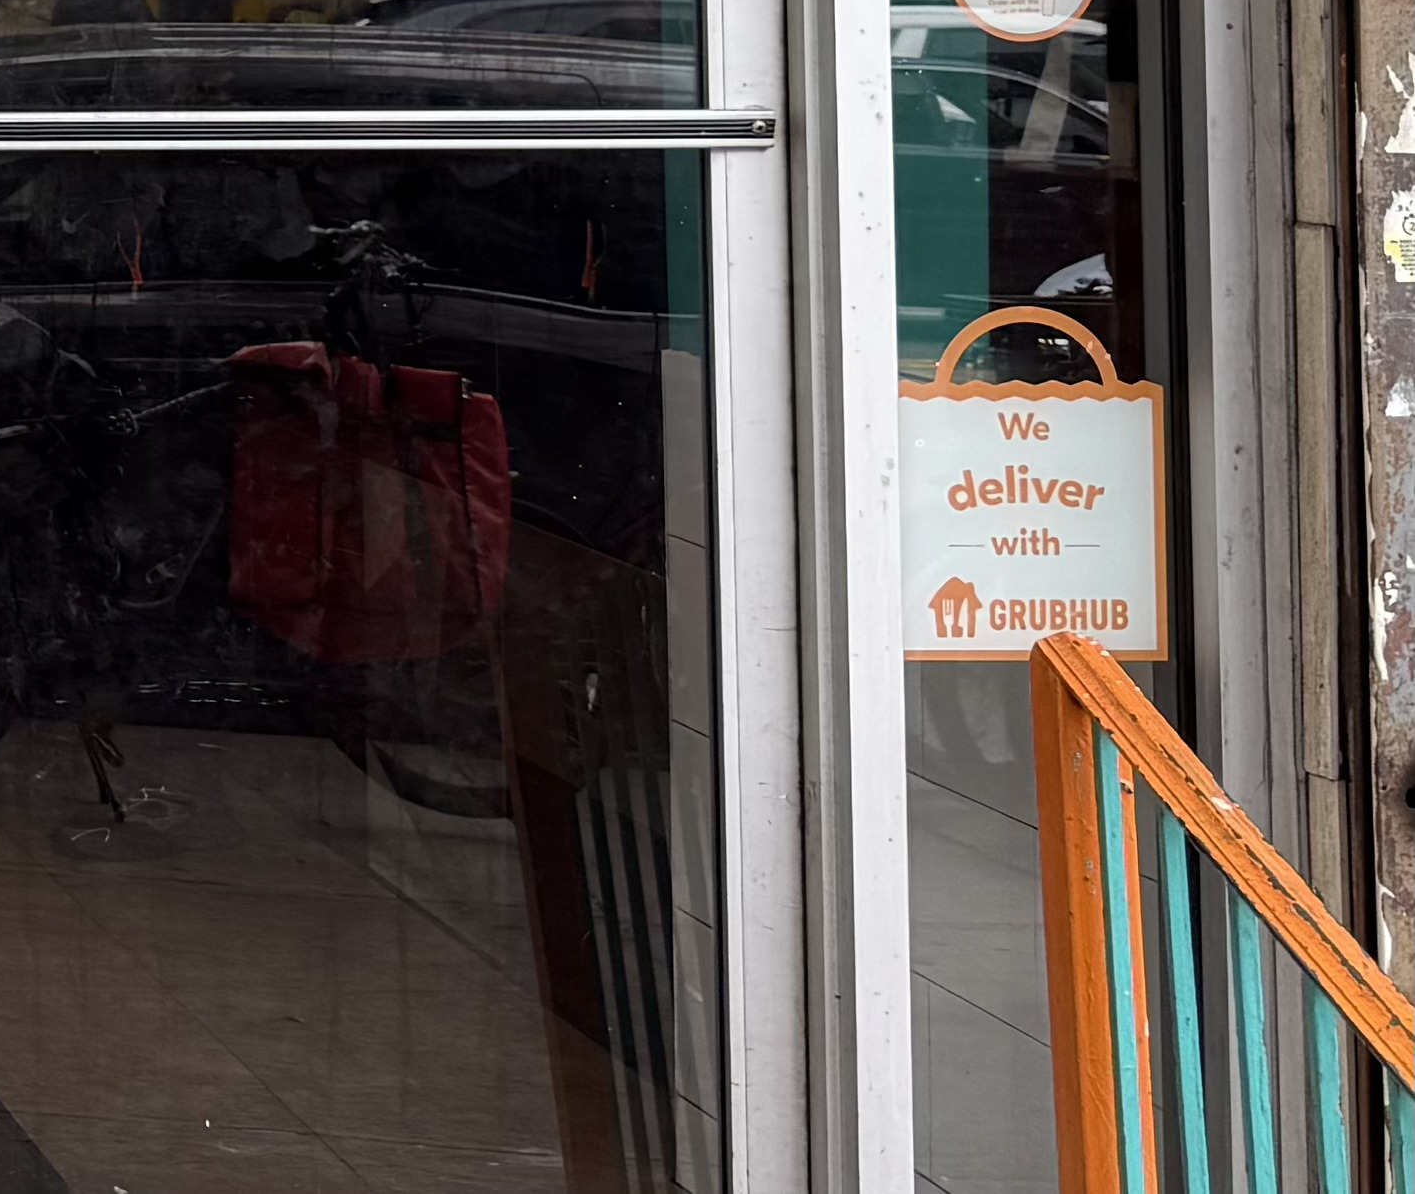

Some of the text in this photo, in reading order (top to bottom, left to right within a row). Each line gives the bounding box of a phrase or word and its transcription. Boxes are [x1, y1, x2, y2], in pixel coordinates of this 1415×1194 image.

[997, 411, 1051, 442] We
[946, 464, 1106, 512] deliver
[990, 527, 1061, 557] with
[988, 598, 1129, 632] GRUBHUB
